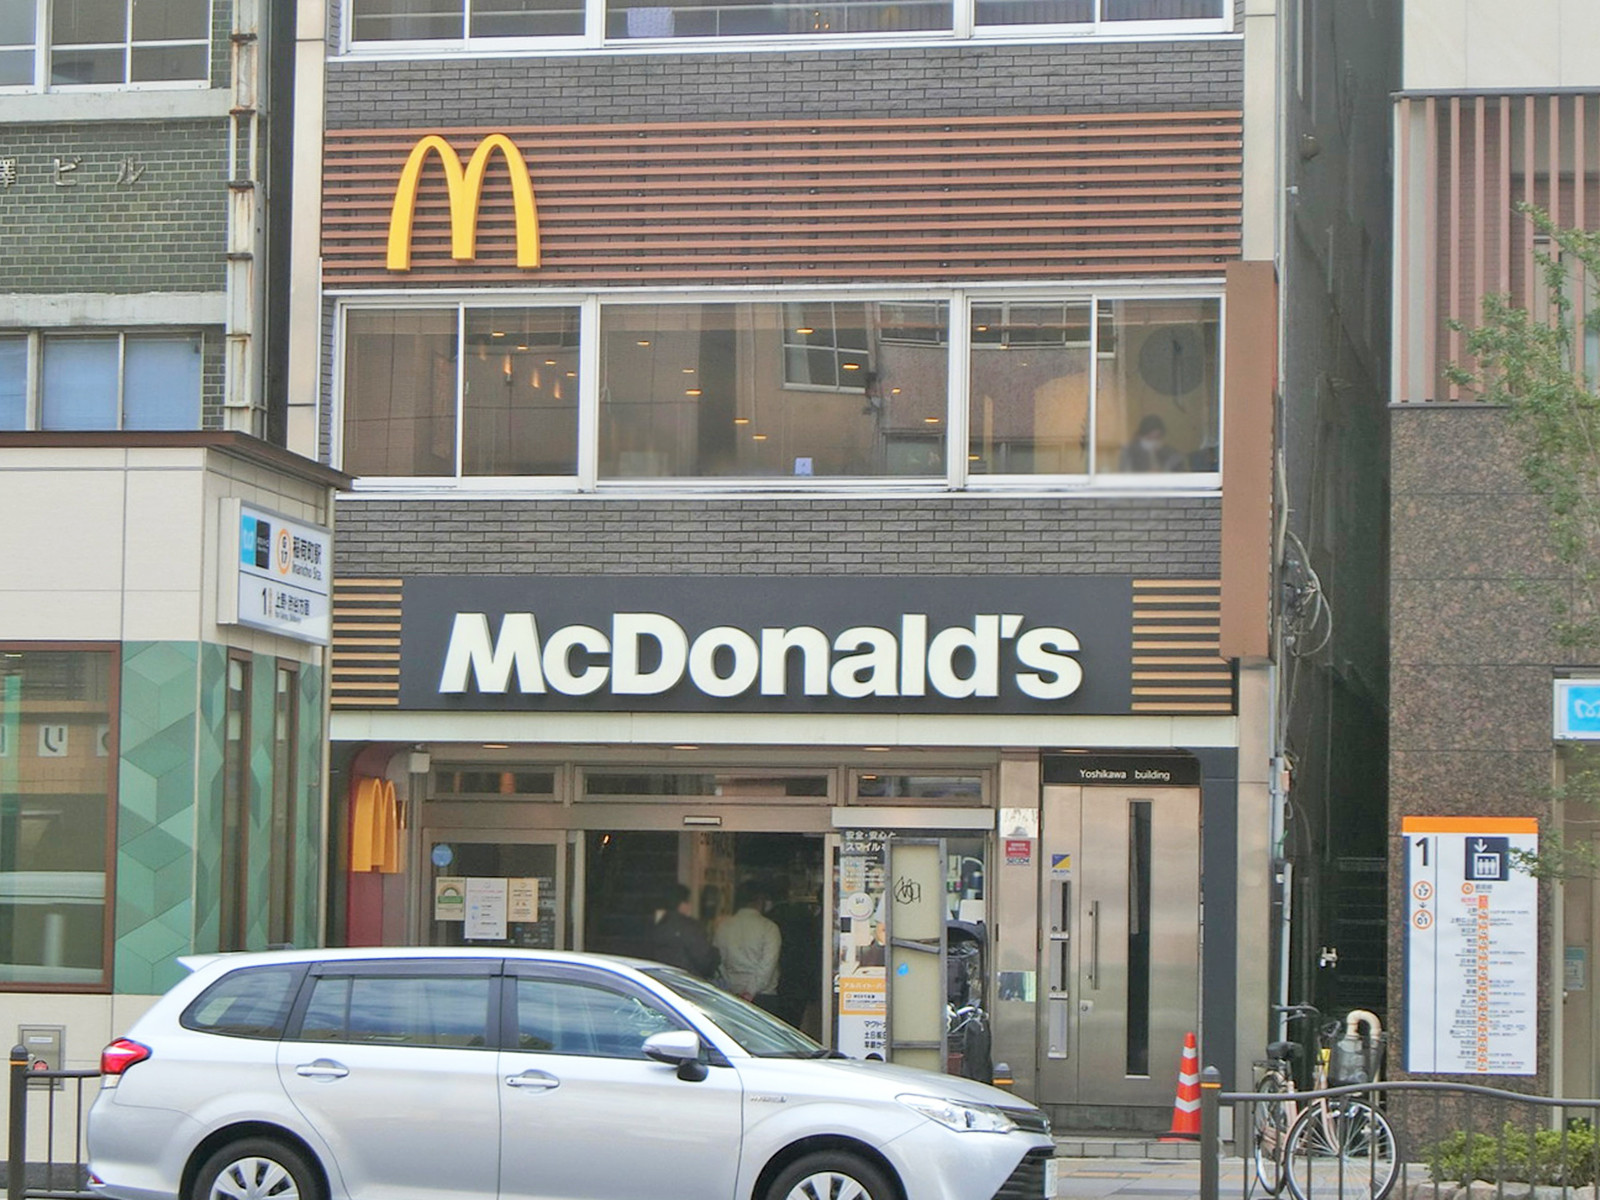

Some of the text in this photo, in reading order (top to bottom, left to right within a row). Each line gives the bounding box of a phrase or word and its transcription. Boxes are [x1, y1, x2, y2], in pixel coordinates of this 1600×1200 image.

[439, 611, 1083, 700] McDonald's
[1079, 769, 1171, 782] Yoshikawa building
[1416, 837, 1429, 867] 1
[1418, 889, 1429, 897] 17
[1417, 917, 1428, 926] 01
